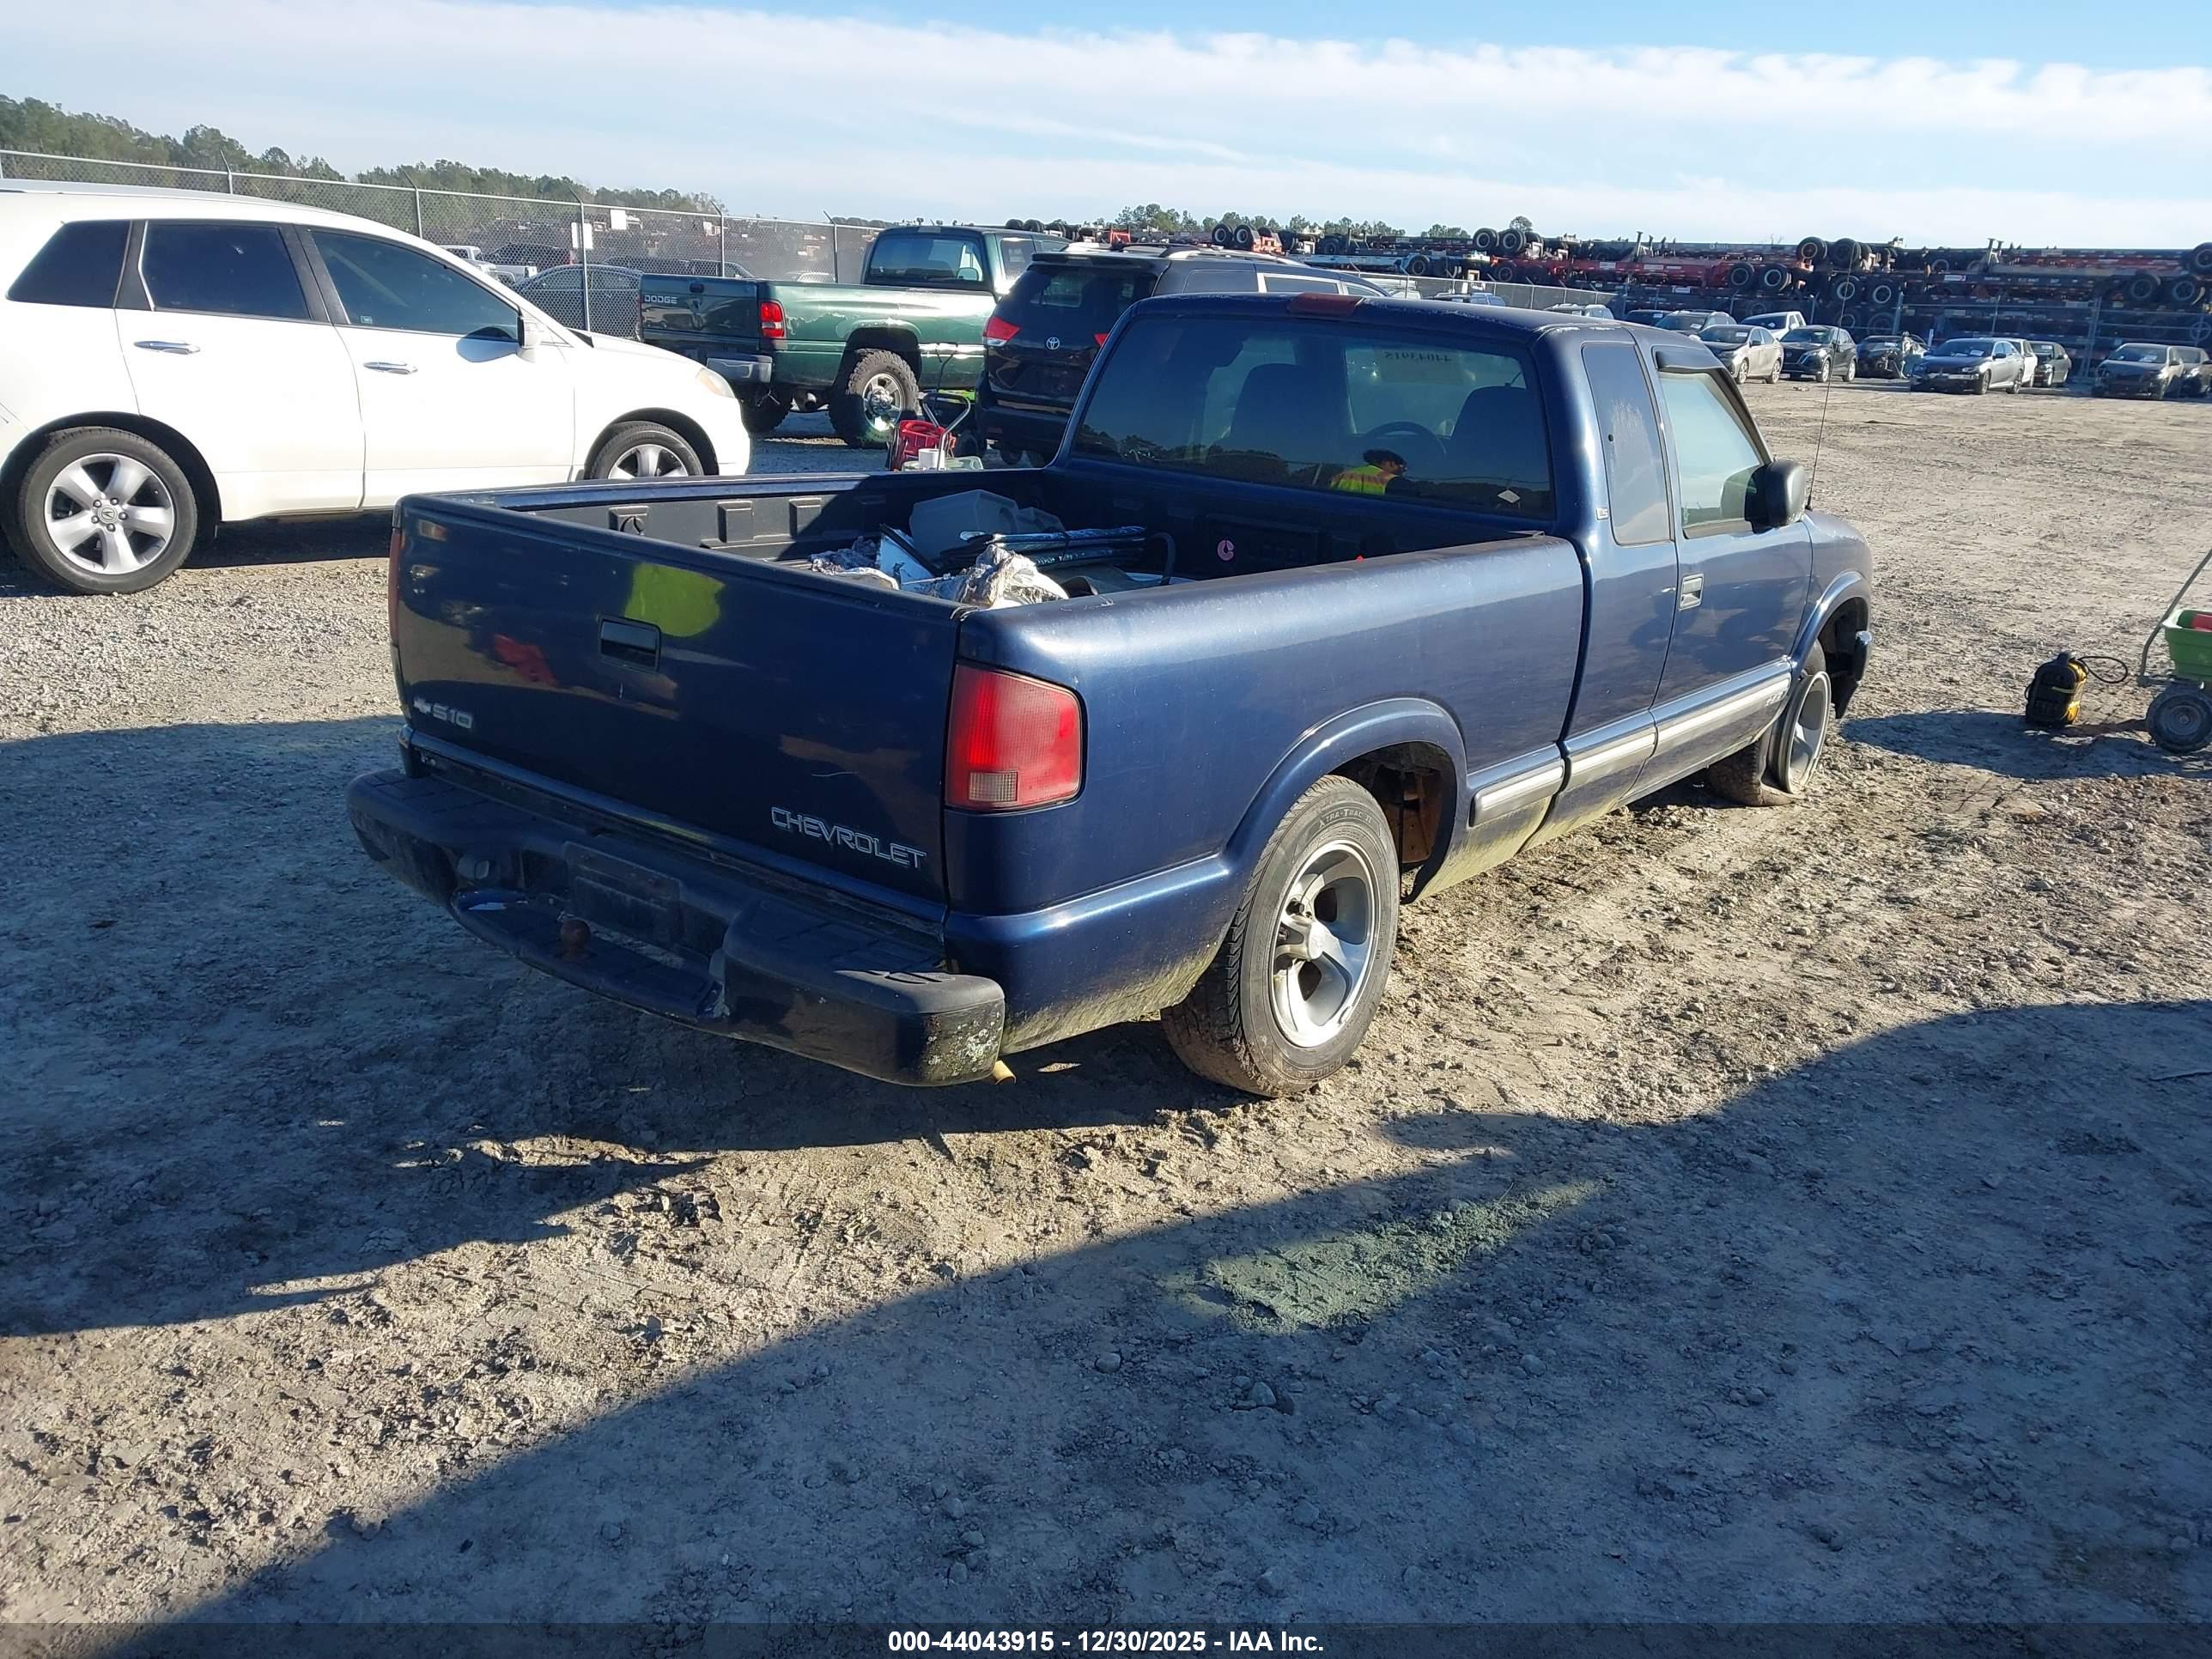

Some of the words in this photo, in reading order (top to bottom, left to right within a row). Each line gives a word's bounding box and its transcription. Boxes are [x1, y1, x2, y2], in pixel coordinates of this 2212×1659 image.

[644, 295, 678, 304] DODGE
[432, 702, 473, 729] S10
[771, 806, 927, 868] CHEVROLET
